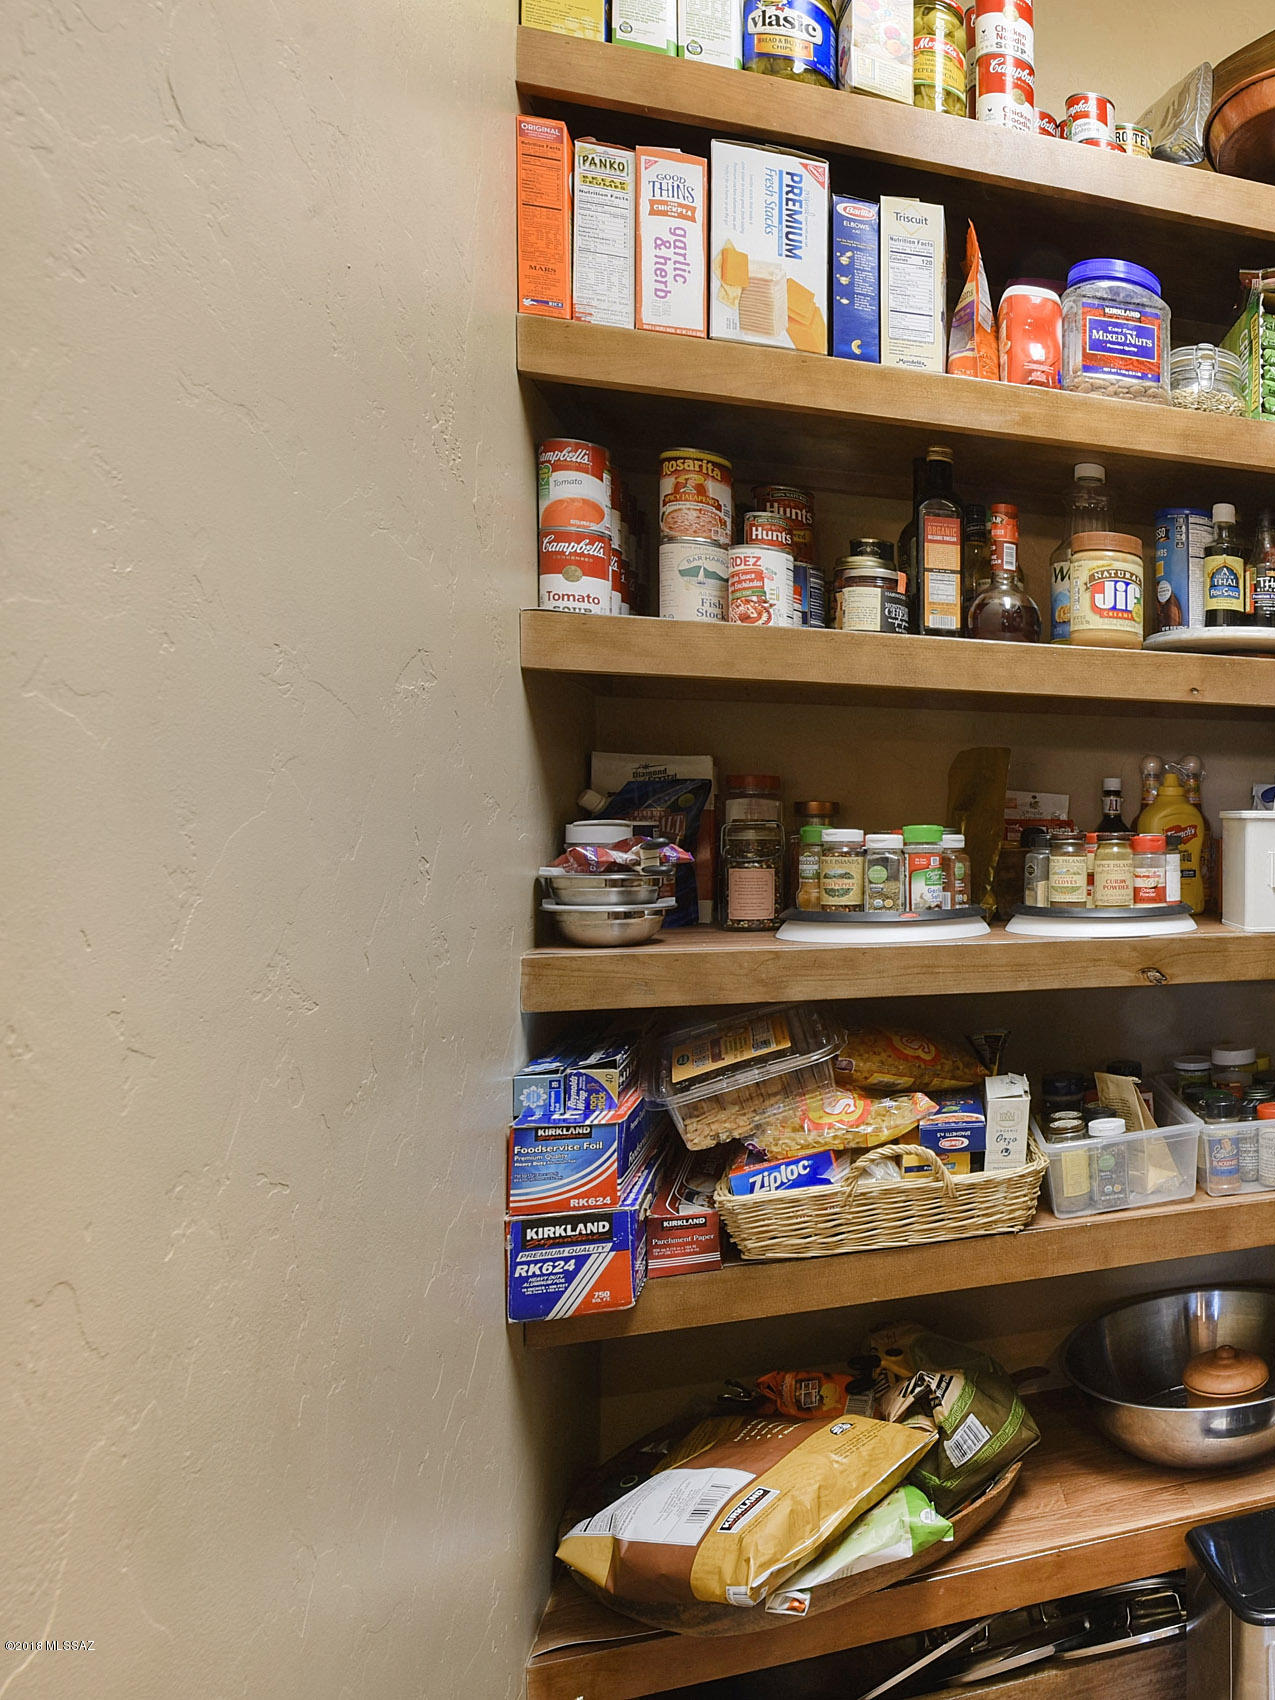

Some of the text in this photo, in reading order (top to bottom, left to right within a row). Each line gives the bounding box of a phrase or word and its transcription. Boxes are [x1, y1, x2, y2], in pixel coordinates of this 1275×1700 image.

[520, 122, 561, 136] ORIGINAL
[581, 154, 626, 173] PANKO
[656, 173, 687, 185] GOOD
[579, 188, 629, 201] Nutrition Facts
[765, 167, 777, 236] Fresh Stacks
[653, 204, 692, 217] CHICKPEA
[785, 171, 803, 260] PREMIUM
[893, 211, 929, 226] Triscuit
[843, 220, 870, 231] ELBOWS
[654, 236, 672, 250] &
[889, 236, 934, 248] Nutrition Facts
[669, 226, 691, 285] garlic
[528, 264, 557, 274] MARS
[654, 255, 672, 299] herb
[1104, 307, 1141, 319] KIRKLAND
[1092, 330, 1125, 343] MIXED
[662, 459, 722, 481] Rosarita
[553, 478, 583, 488] Tomato
[927, 526, 957, 536] ORGANIC
[542, 535, 607, 559] Campbell's
[729, 556, 762, 568] RDEZ
[1094, 569, 1141, 585] NATURAL
[546, 591, 601, 606] Tomato
[1094, 580, 1141, 610] Jif
[700, 598, 724, 610] Fish
[696, 608, 728, 621] Stock
[567, 1075, 578, 1109] Reynolds
[577, 1090, 588, 1110] Wrap
[537, 1126, 591, 1136] KIRKLAND
[995, 1134, 1018, 1146] Orzo
[514, 1141, 603, 1154] Foodservice Foil
[544, 1153, 568, 1161] Quality
[749, 1159, 811, 1195] Ziploc
[569, 1196, 612, 1207] RK624
[663, 1217, 706, 1227] KIRKLAND
[526, 1221, 610, 1240] KIRKLAND
[652, 1234, 715, 1245] Parchment Paper
[520, 1245, 609, 1260] PREMIUM QUALITY
[514, 1259, 576, 1277] RK624
[593, 1291, 610, 1299] 750
[722, 1489, 764, 1529] KIRKLAND
